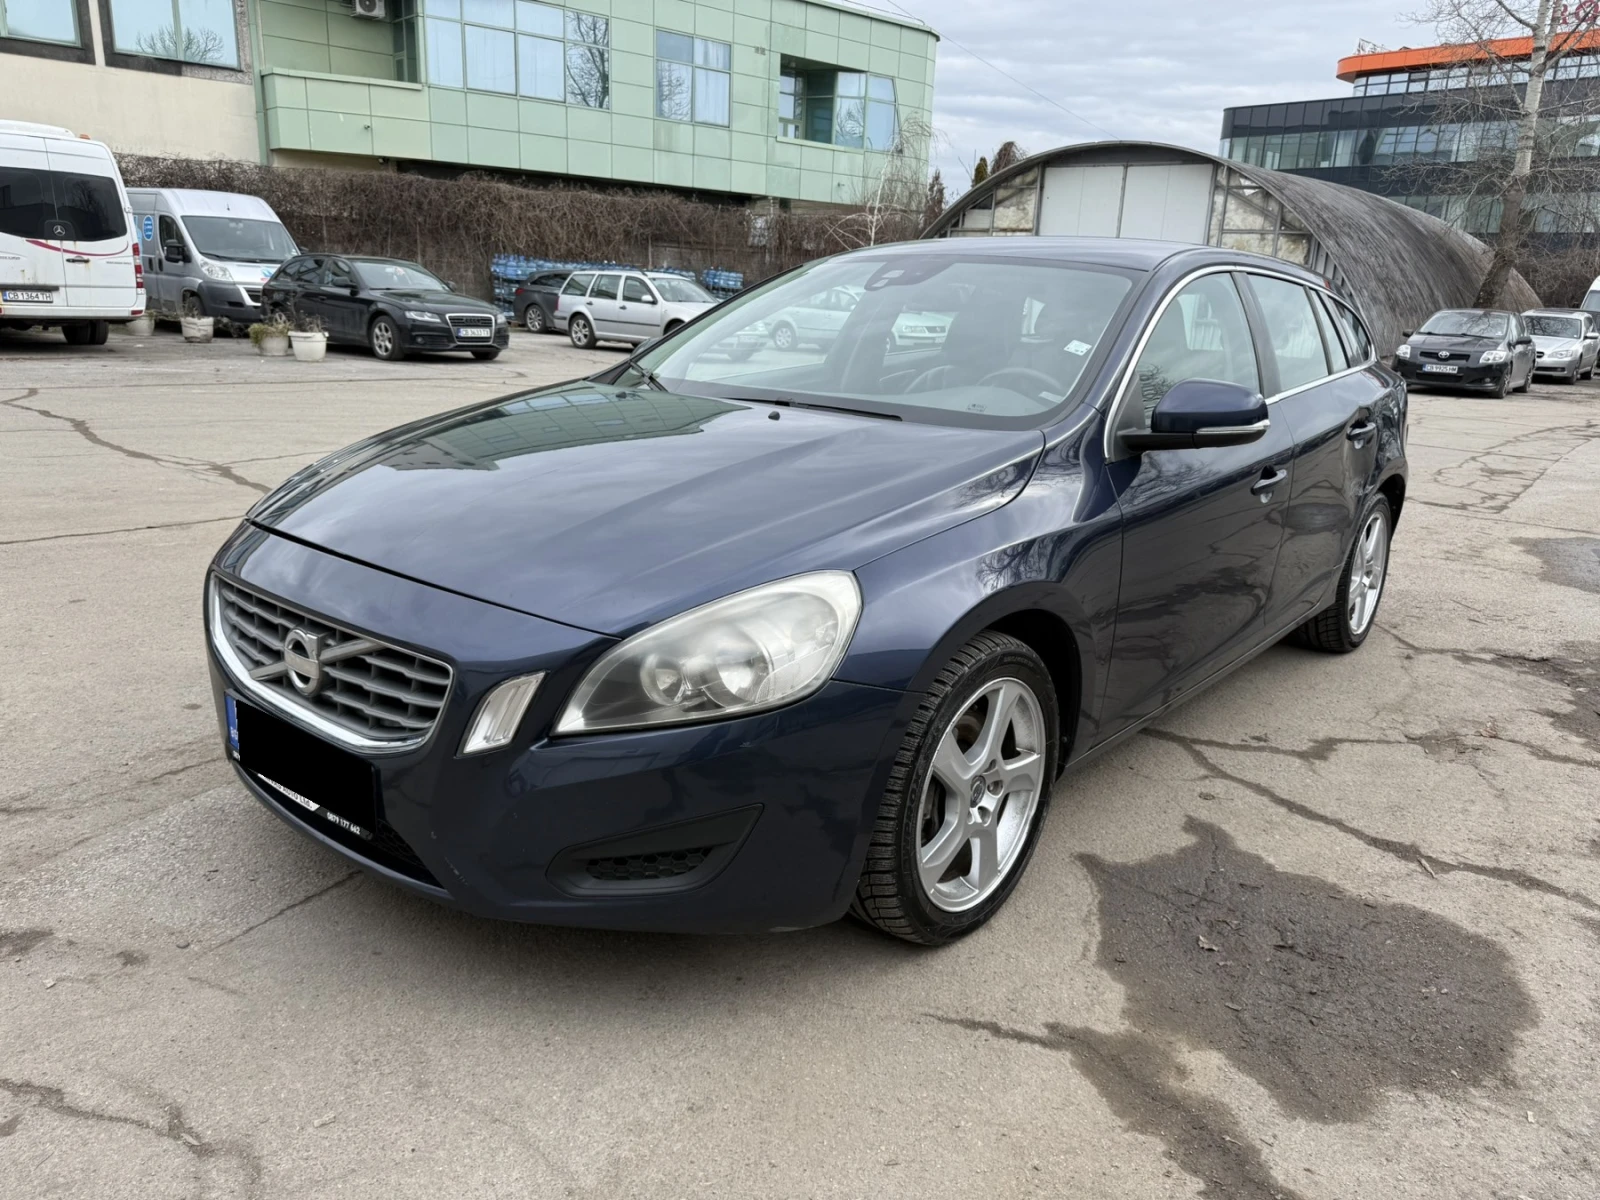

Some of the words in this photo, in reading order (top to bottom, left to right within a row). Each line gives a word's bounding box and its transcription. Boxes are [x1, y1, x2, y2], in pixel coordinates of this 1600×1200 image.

[8, 292, 19, 300] CB
[21, 292, 39, 300] 1364
[40, 292, 51, 301] TH
[326, 811, 339, 824] 0879
